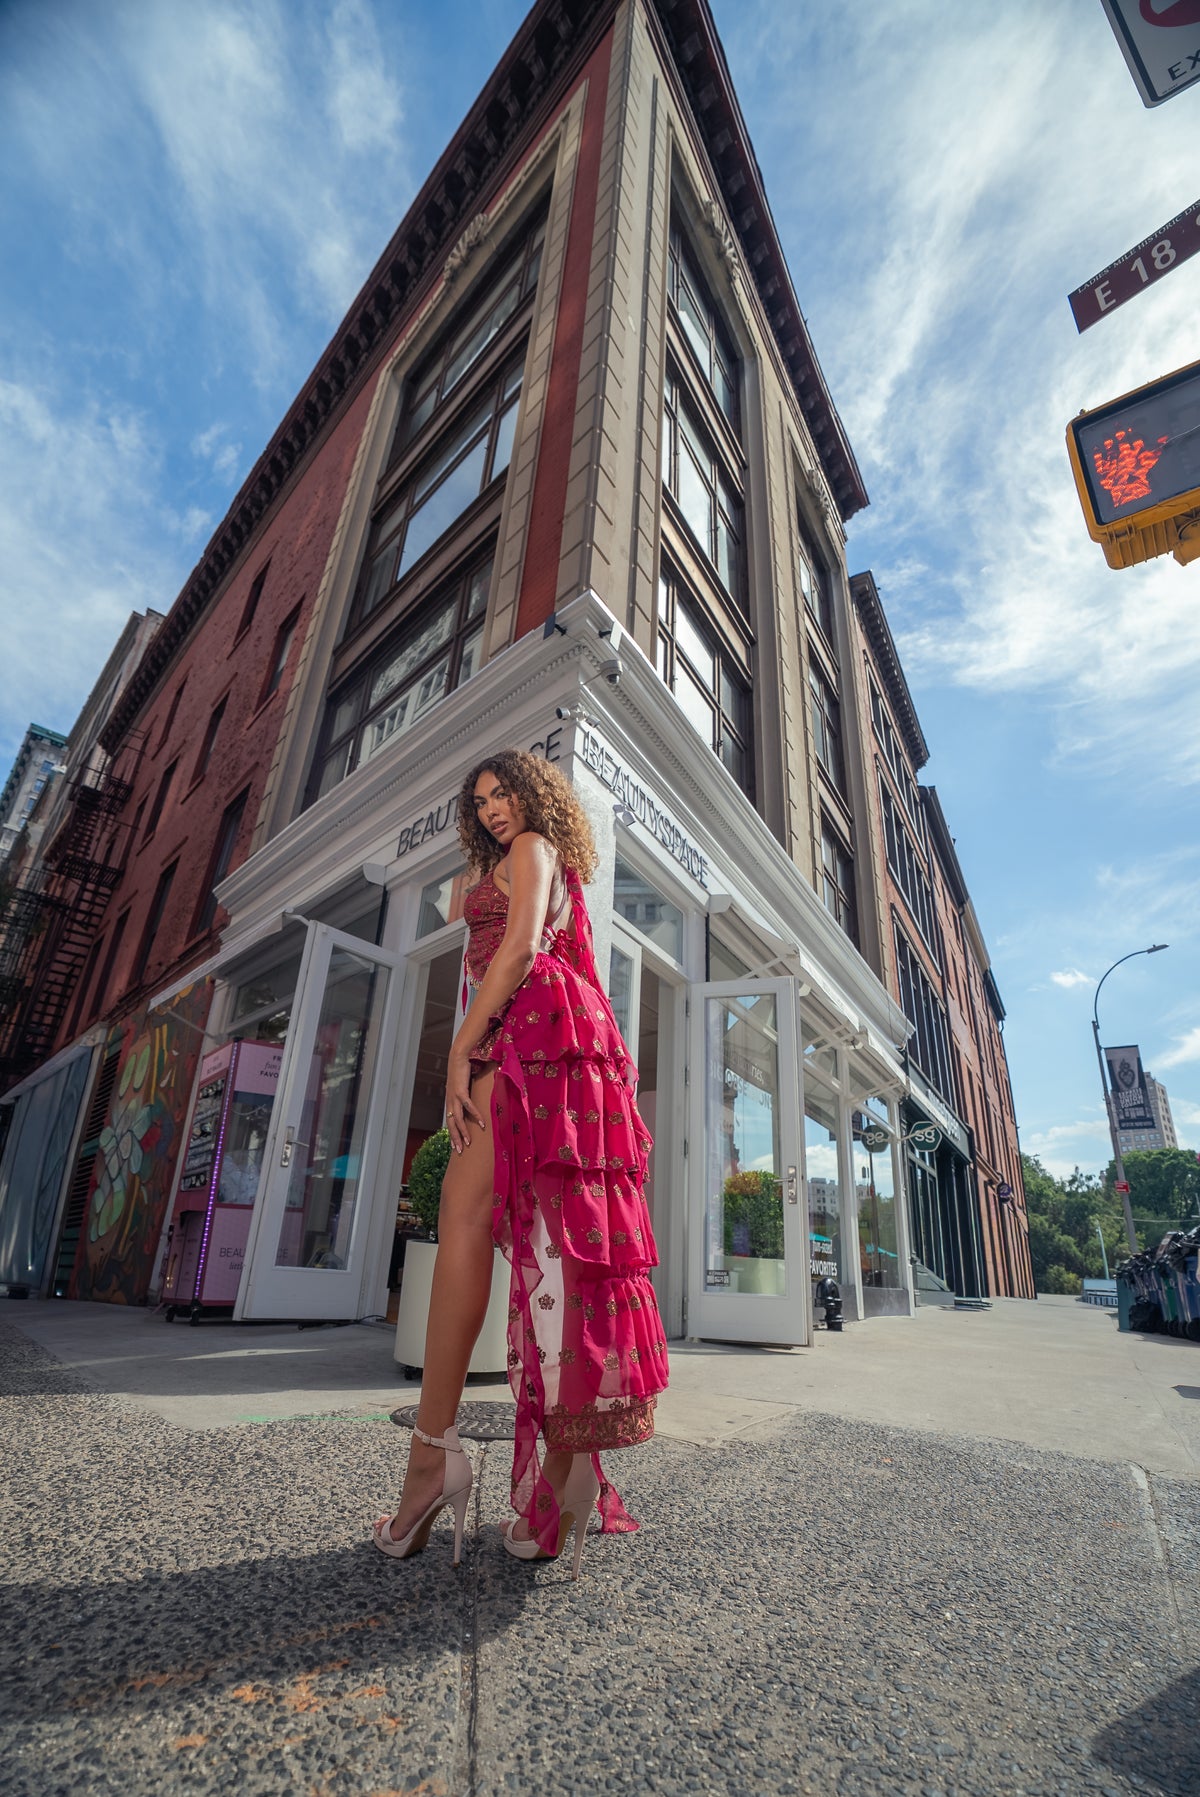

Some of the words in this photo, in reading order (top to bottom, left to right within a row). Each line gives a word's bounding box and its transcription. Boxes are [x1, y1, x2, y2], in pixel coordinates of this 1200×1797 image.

[1113, 250, 1137, 269] MILE
[1138, 214, 1183, 249] HISTORIC
[1094, 280, 1116, 312] E
[1130, 239, 1176, 283] 18
[915, 1129, 936, 1143] sg
[810, 1259, 838, 1277] FAVORITES
